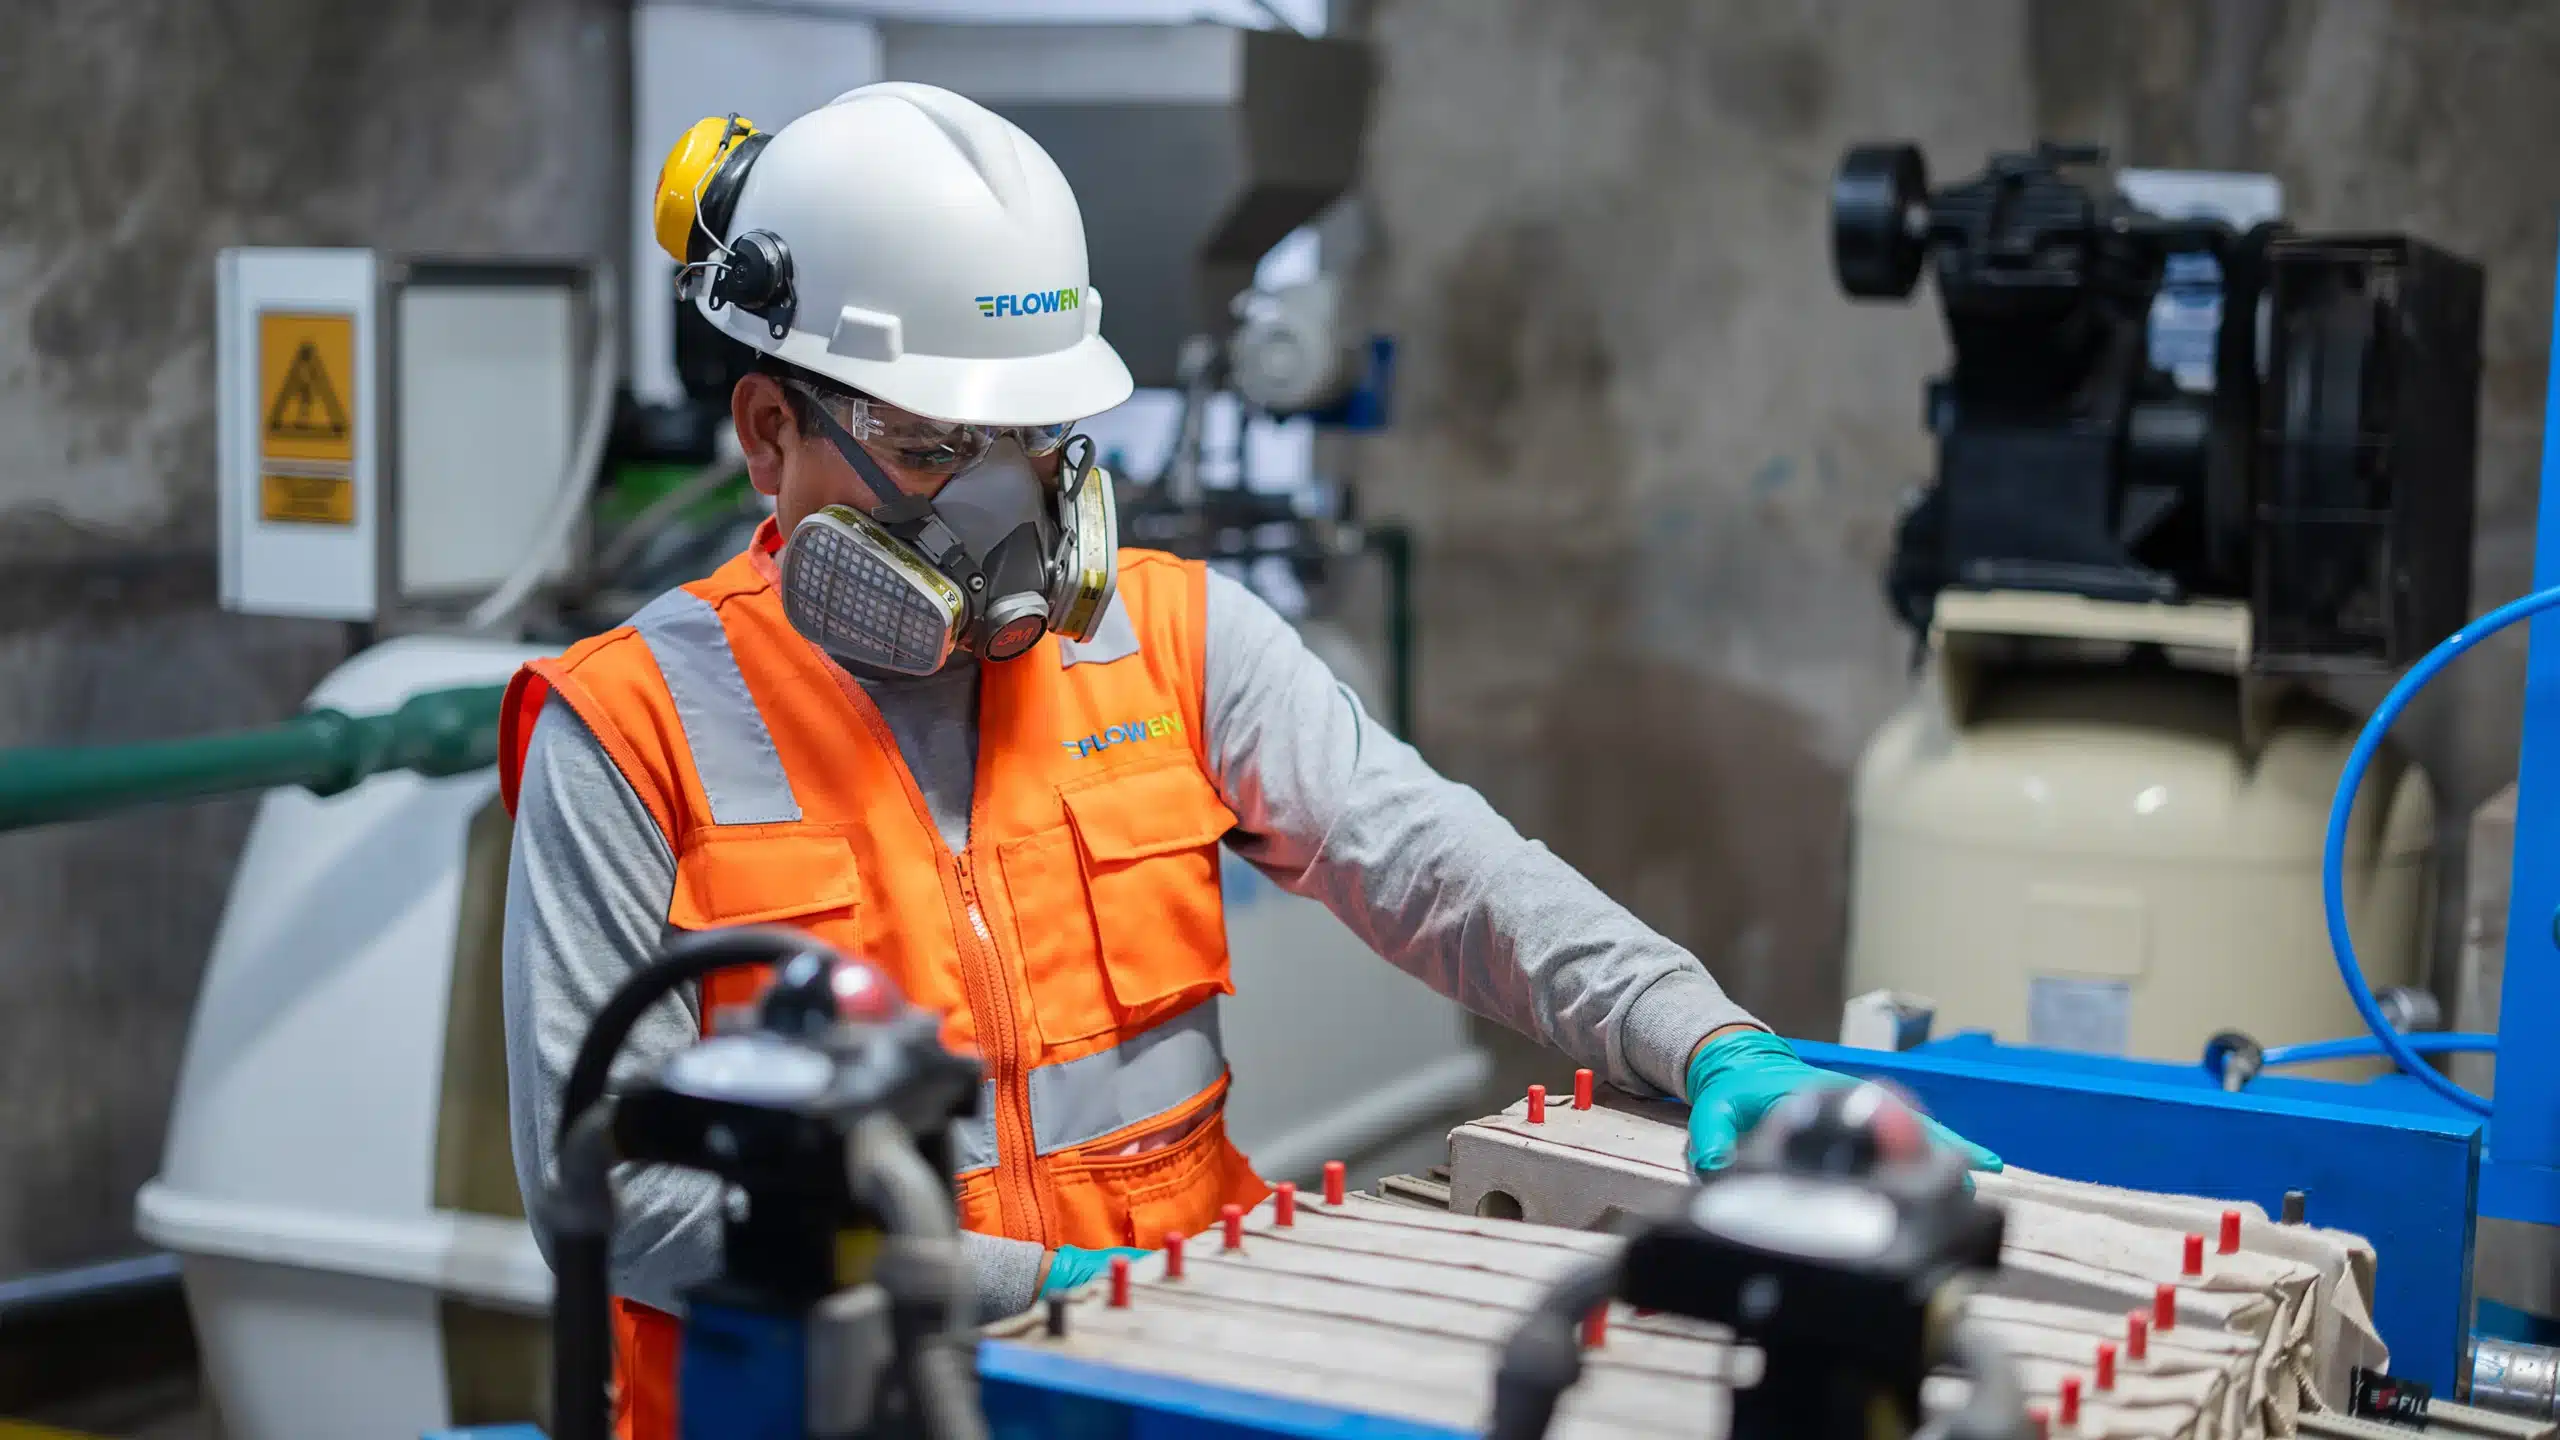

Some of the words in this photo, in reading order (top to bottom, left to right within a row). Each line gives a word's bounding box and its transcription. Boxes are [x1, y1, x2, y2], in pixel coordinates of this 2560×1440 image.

[995, 287, 1079, 317] FLOWEN
[996, 627, 1034, 646] 3M
[1077, 712, 1182, 757] FLOWEN
